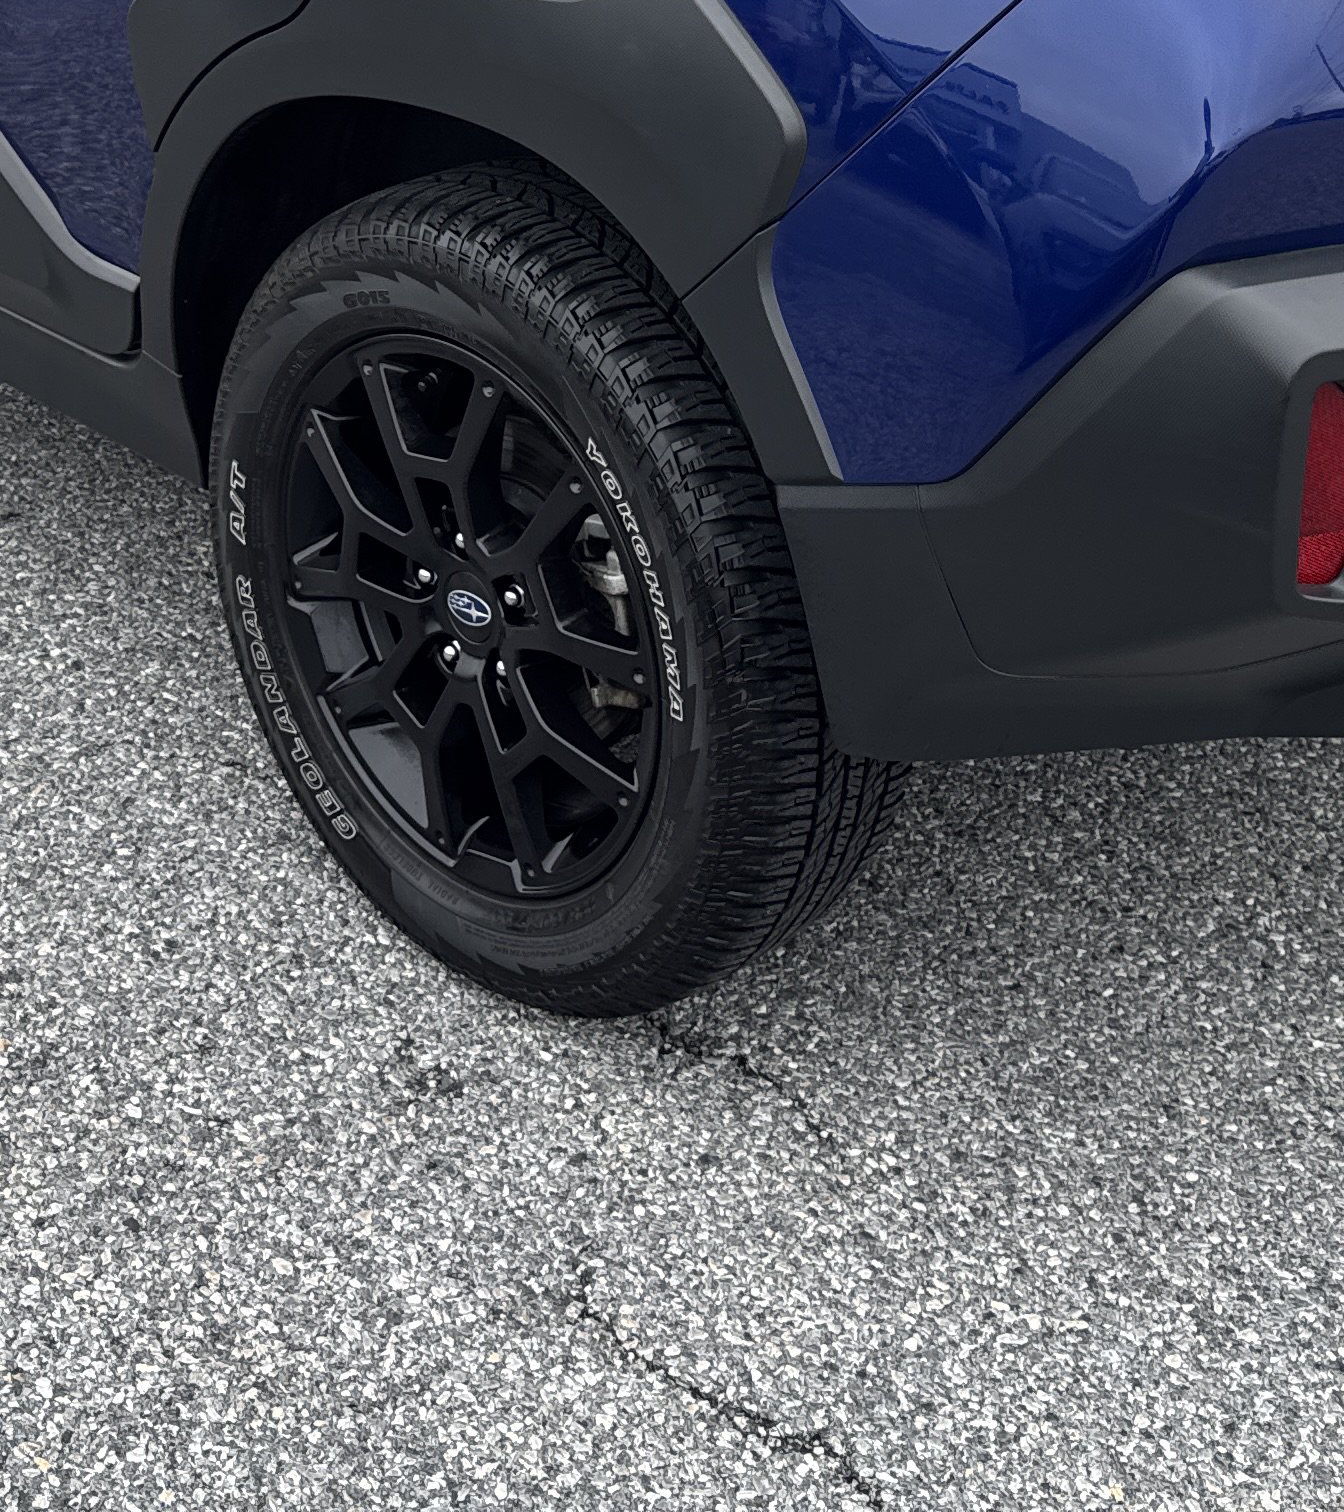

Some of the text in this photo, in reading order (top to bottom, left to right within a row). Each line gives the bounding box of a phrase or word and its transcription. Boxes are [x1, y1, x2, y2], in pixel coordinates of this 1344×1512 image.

[229, 459, 358, 841] GEOLANDAR A/T
[585, 436, 684, 722] YOKOHAMA
